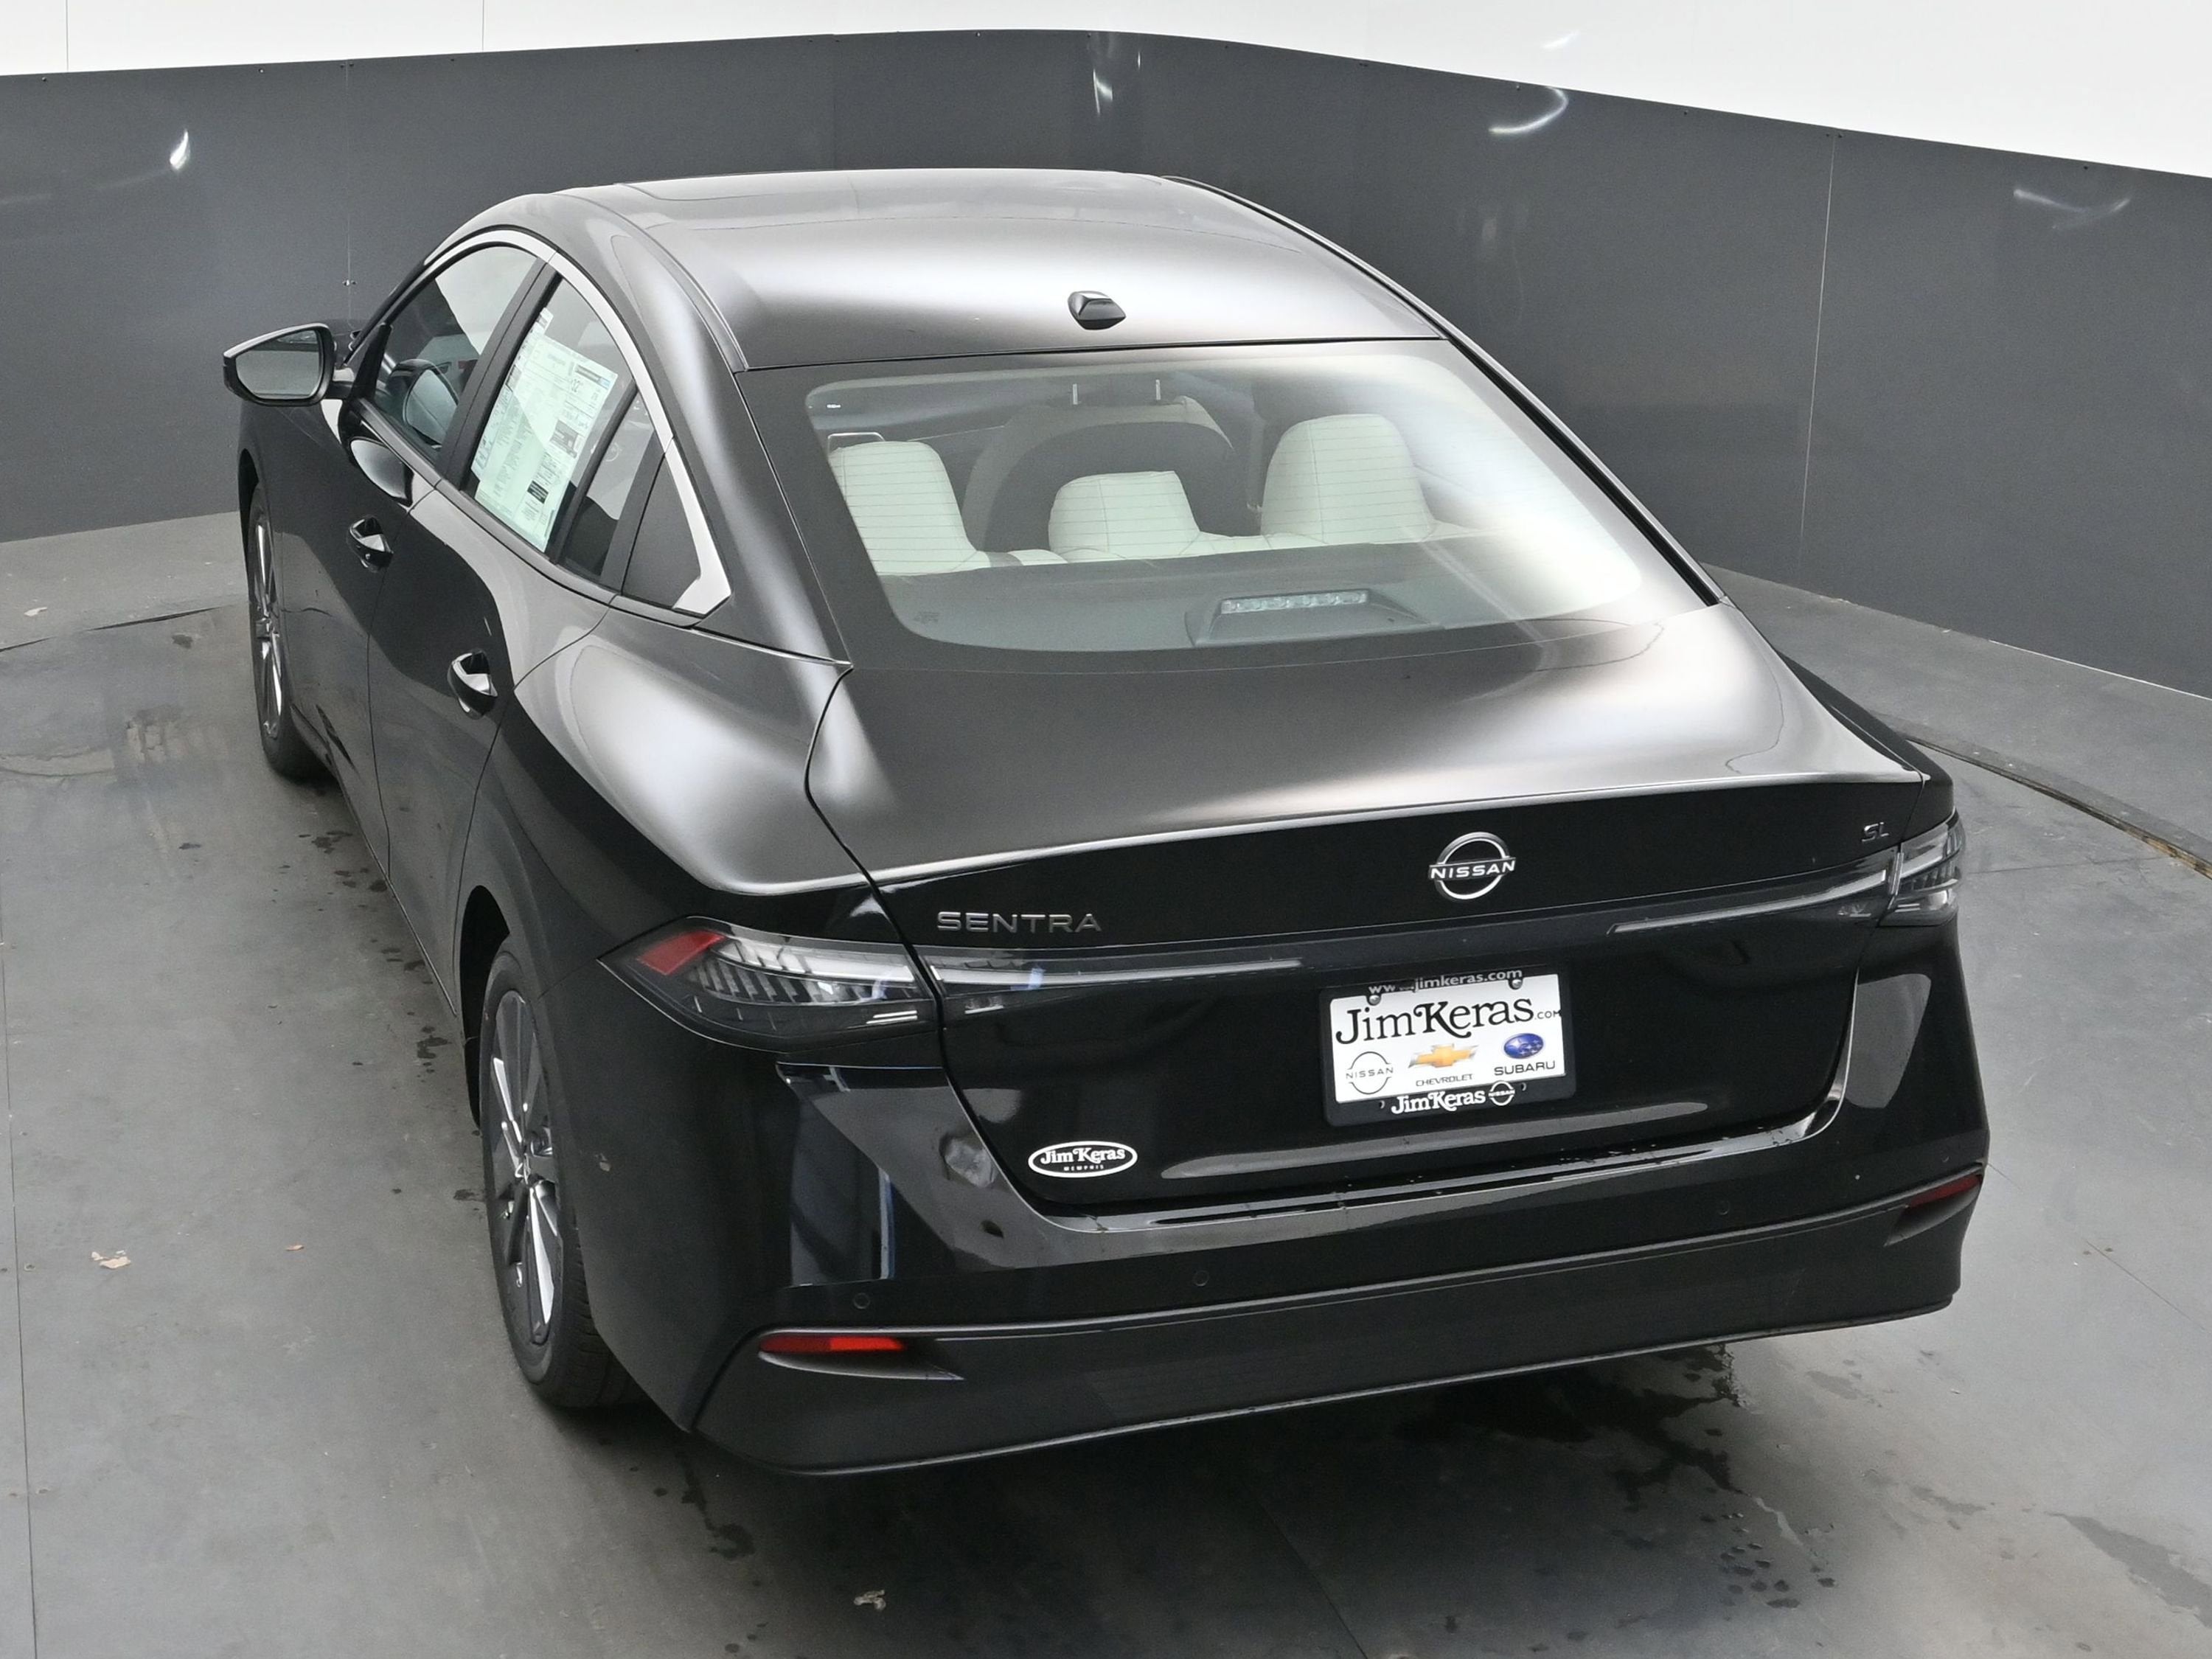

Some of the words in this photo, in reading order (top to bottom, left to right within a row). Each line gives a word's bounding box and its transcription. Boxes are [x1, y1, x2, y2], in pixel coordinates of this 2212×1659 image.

[1862, 821, 1890, 842] SL
[1430, 860, 1516, 879] NISSAN
[936, 911, 1102, 933] SENTRA
[1346, 1066, 1394, 1080] NISSAN
[1494, 1060, 1556, 1077] SUBARU
[1415, 1073, 1473, 1088] CHEVROLET
